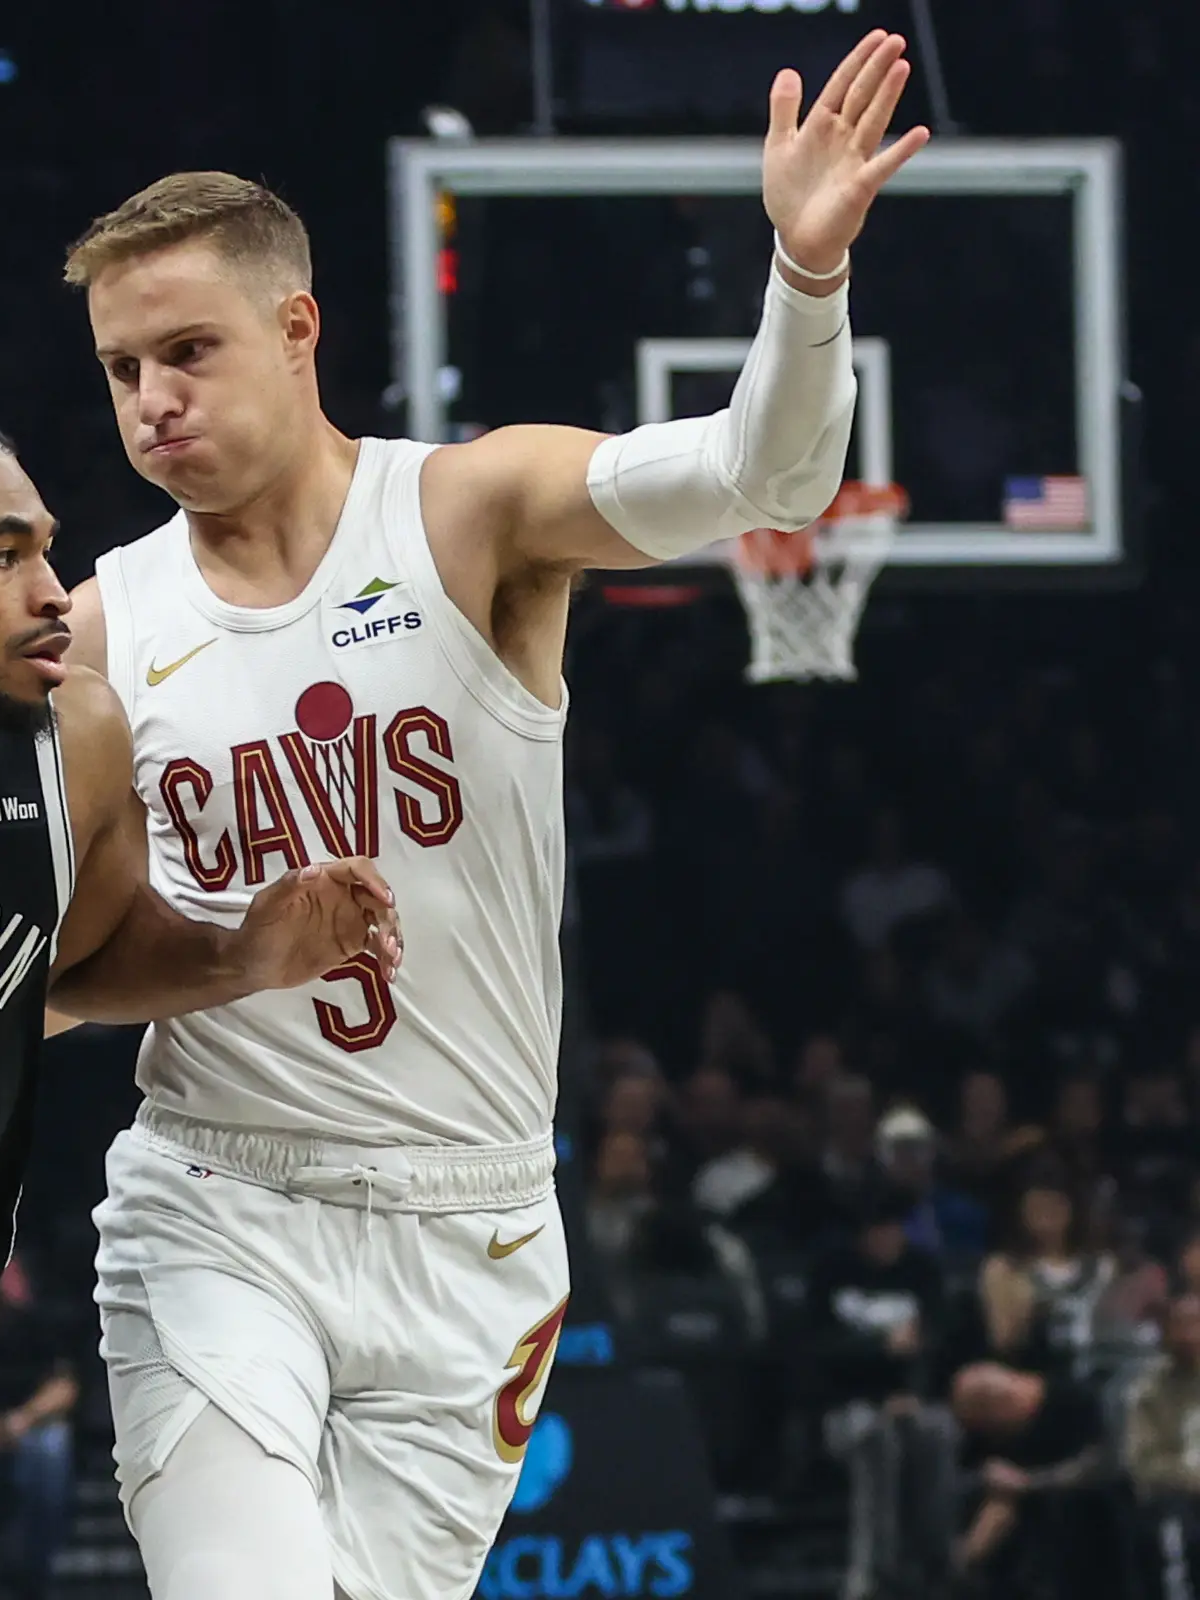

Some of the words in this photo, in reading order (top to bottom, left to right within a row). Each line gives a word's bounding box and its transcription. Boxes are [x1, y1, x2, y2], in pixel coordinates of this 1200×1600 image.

[331, 611, 422, 648] CLIFFS
[2, 796, 39, 821] Won
[159, 705, 464, 892] CAVS
